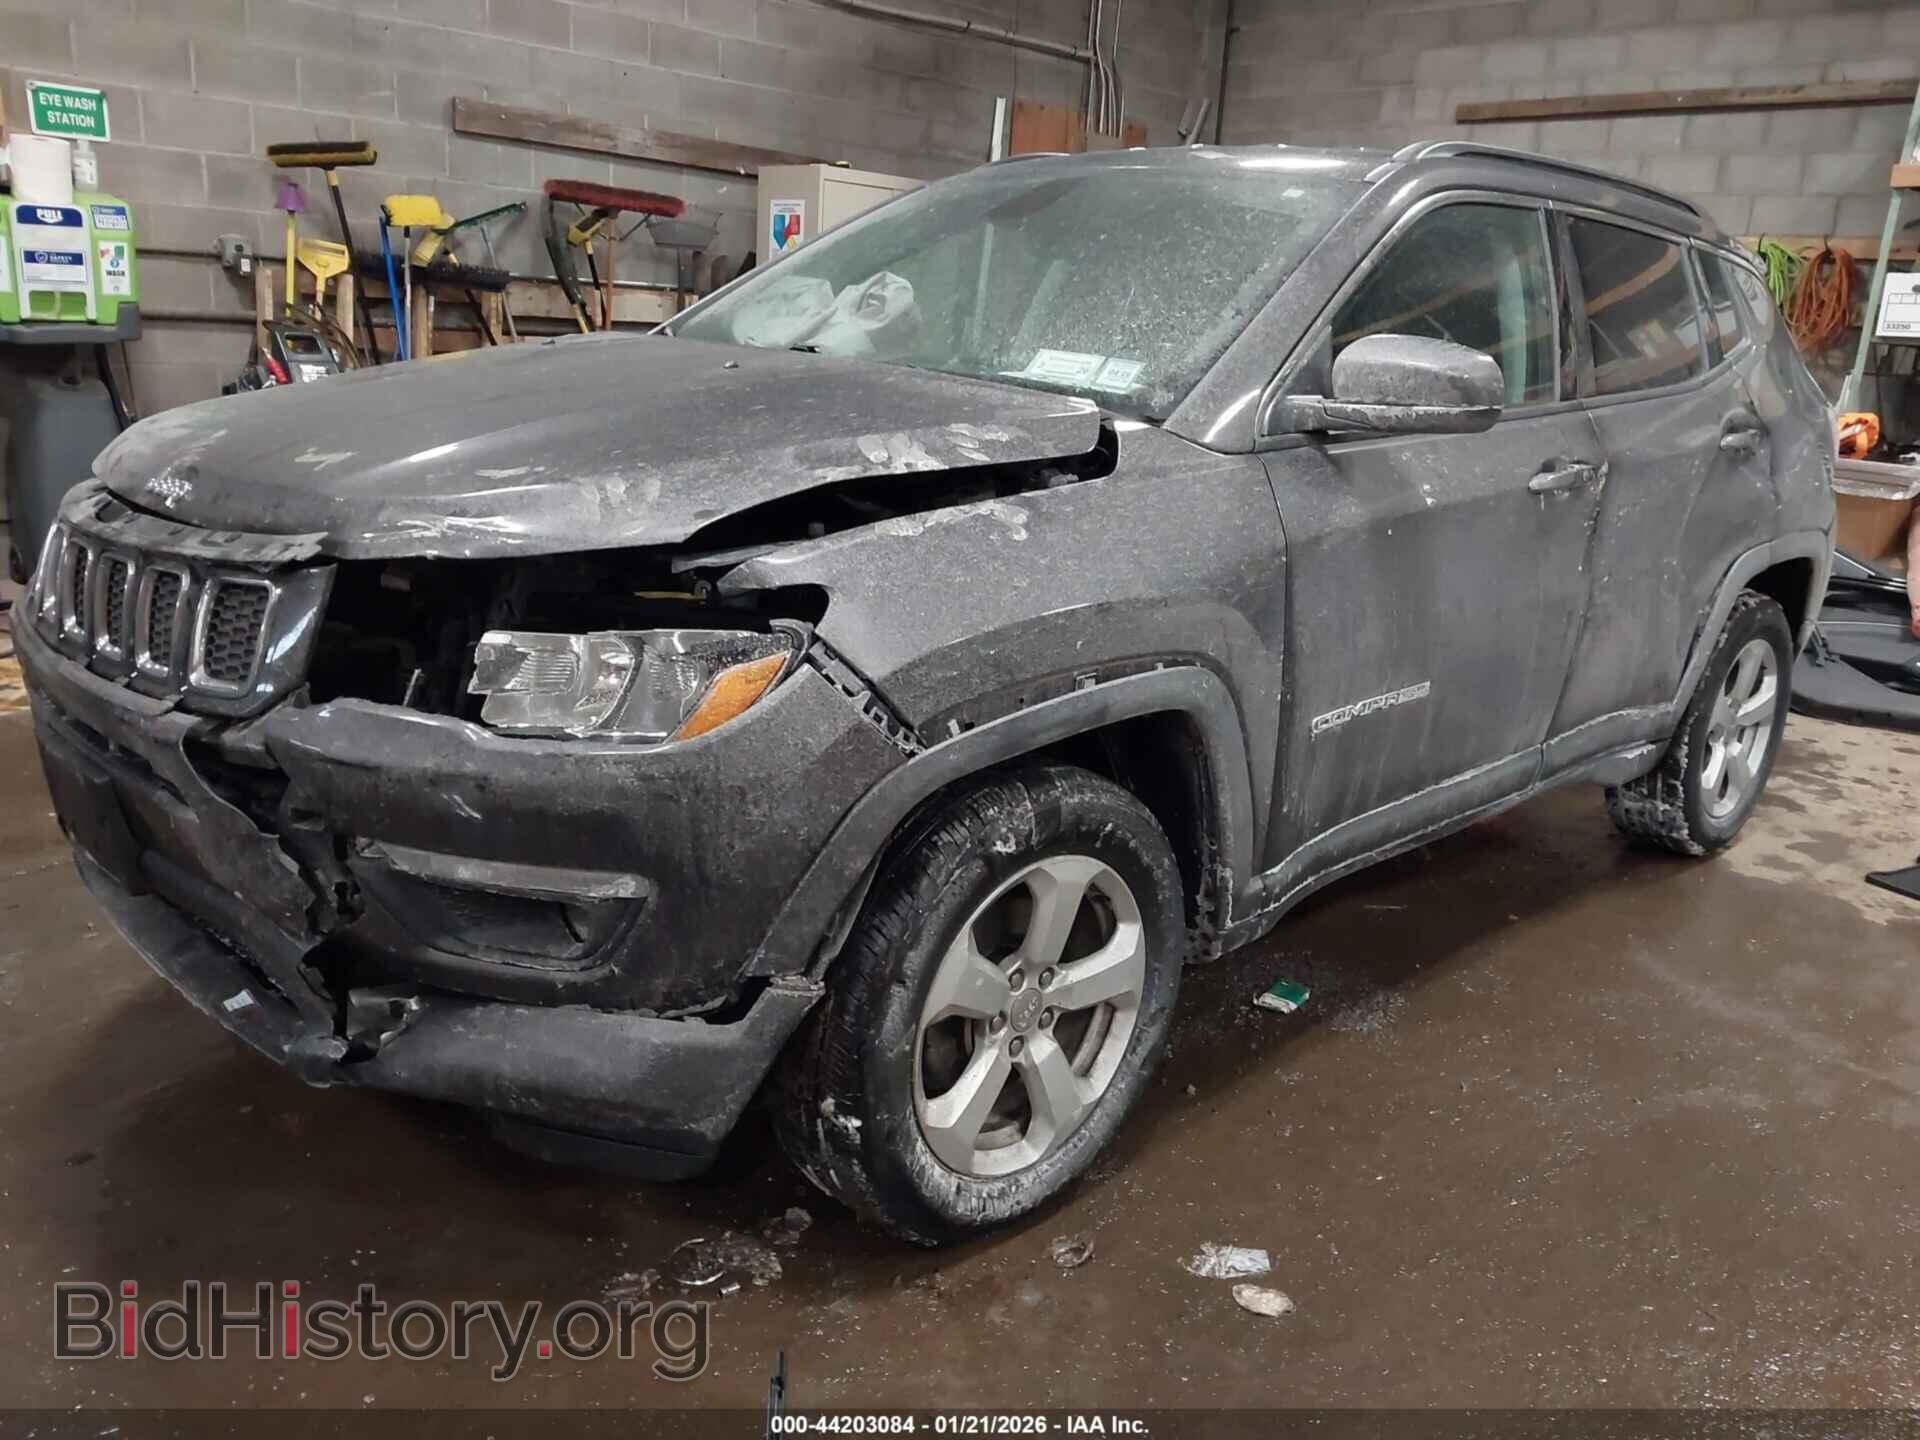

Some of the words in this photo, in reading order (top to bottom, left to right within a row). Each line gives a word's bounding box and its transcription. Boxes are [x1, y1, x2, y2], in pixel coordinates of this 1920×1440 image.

[39, 92, 62, 107] EYE
[63, 95, 96, 111] WASH
[47, 110, 95, 128] STATION
[36, 208, 63, 220] PULL
